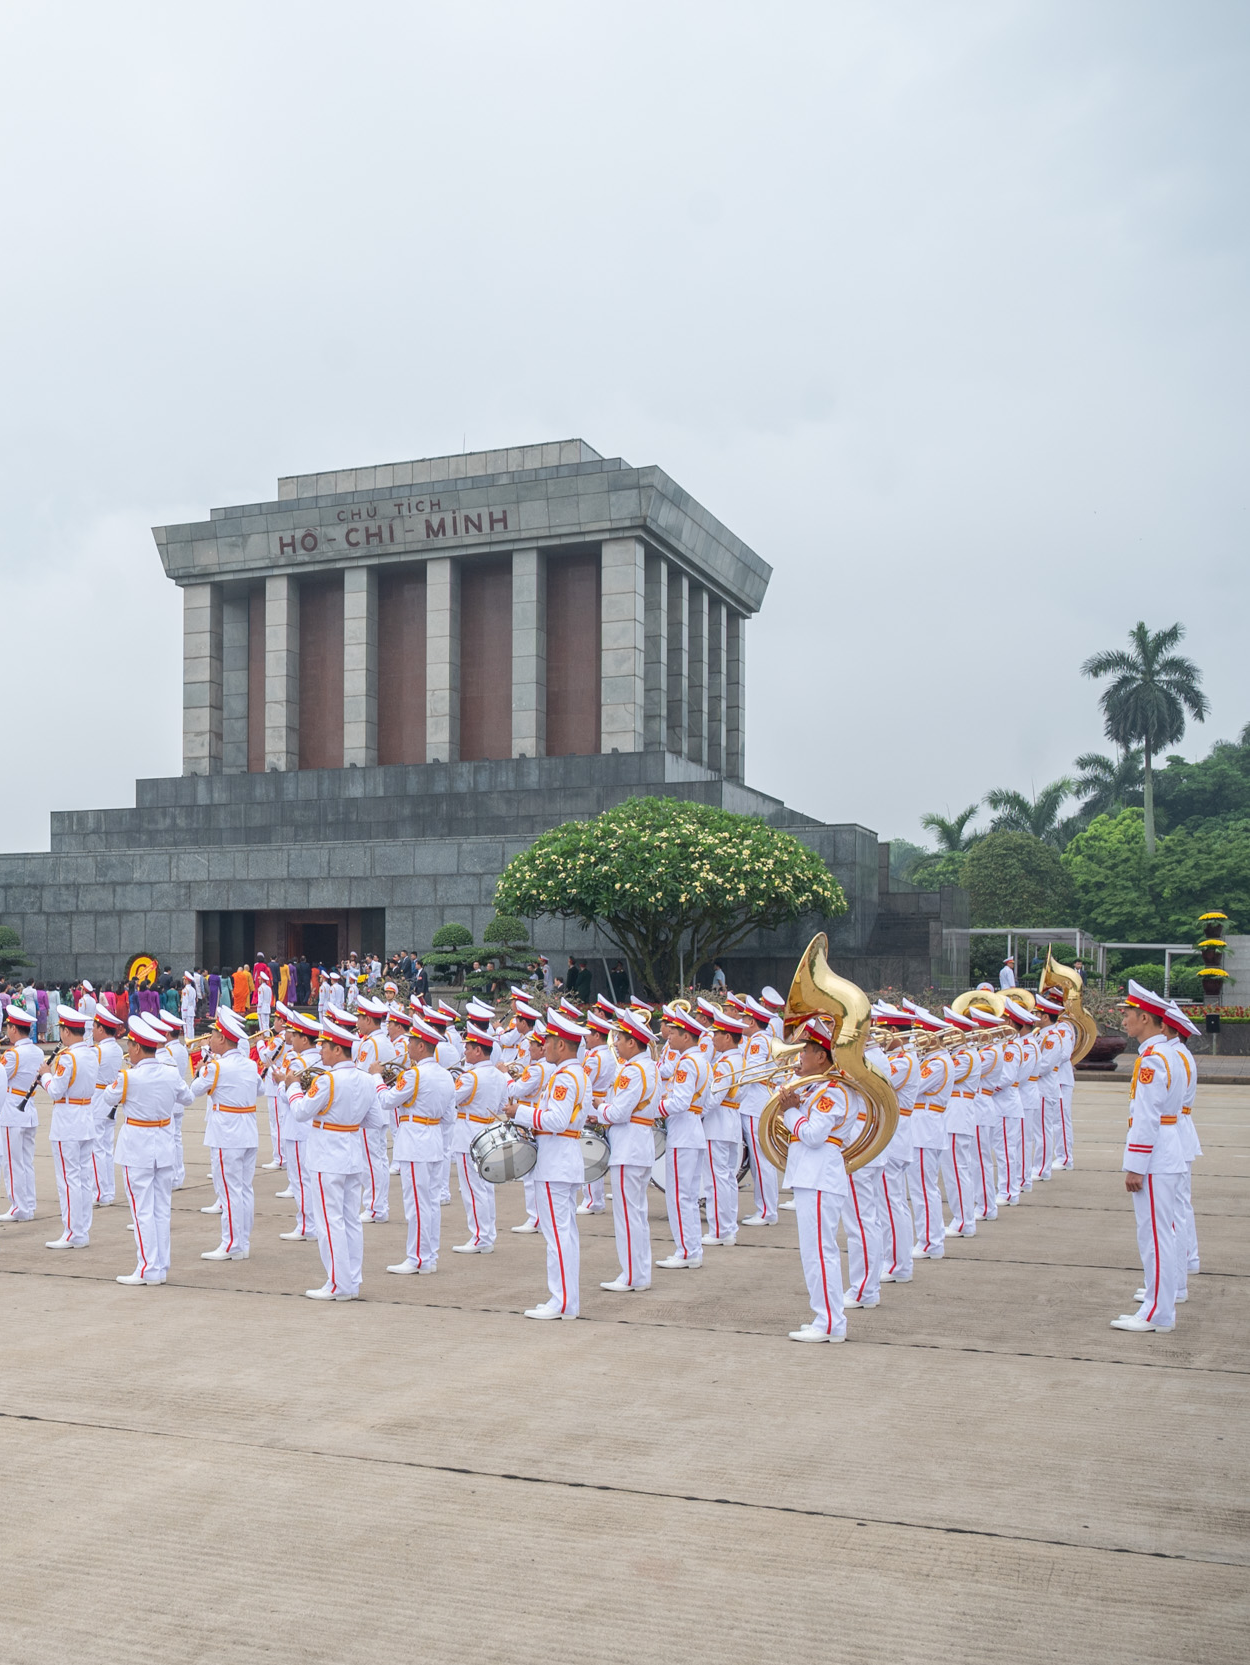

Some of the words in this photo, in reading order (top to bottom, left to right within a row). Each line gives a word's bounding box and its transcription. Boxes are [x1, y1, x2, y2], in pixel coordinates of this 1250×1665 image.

[336, 500, 377, 521] CHỦ
[278, 527, 318, 555] HỒ
[345, 517, 395, 547] CHÍ
